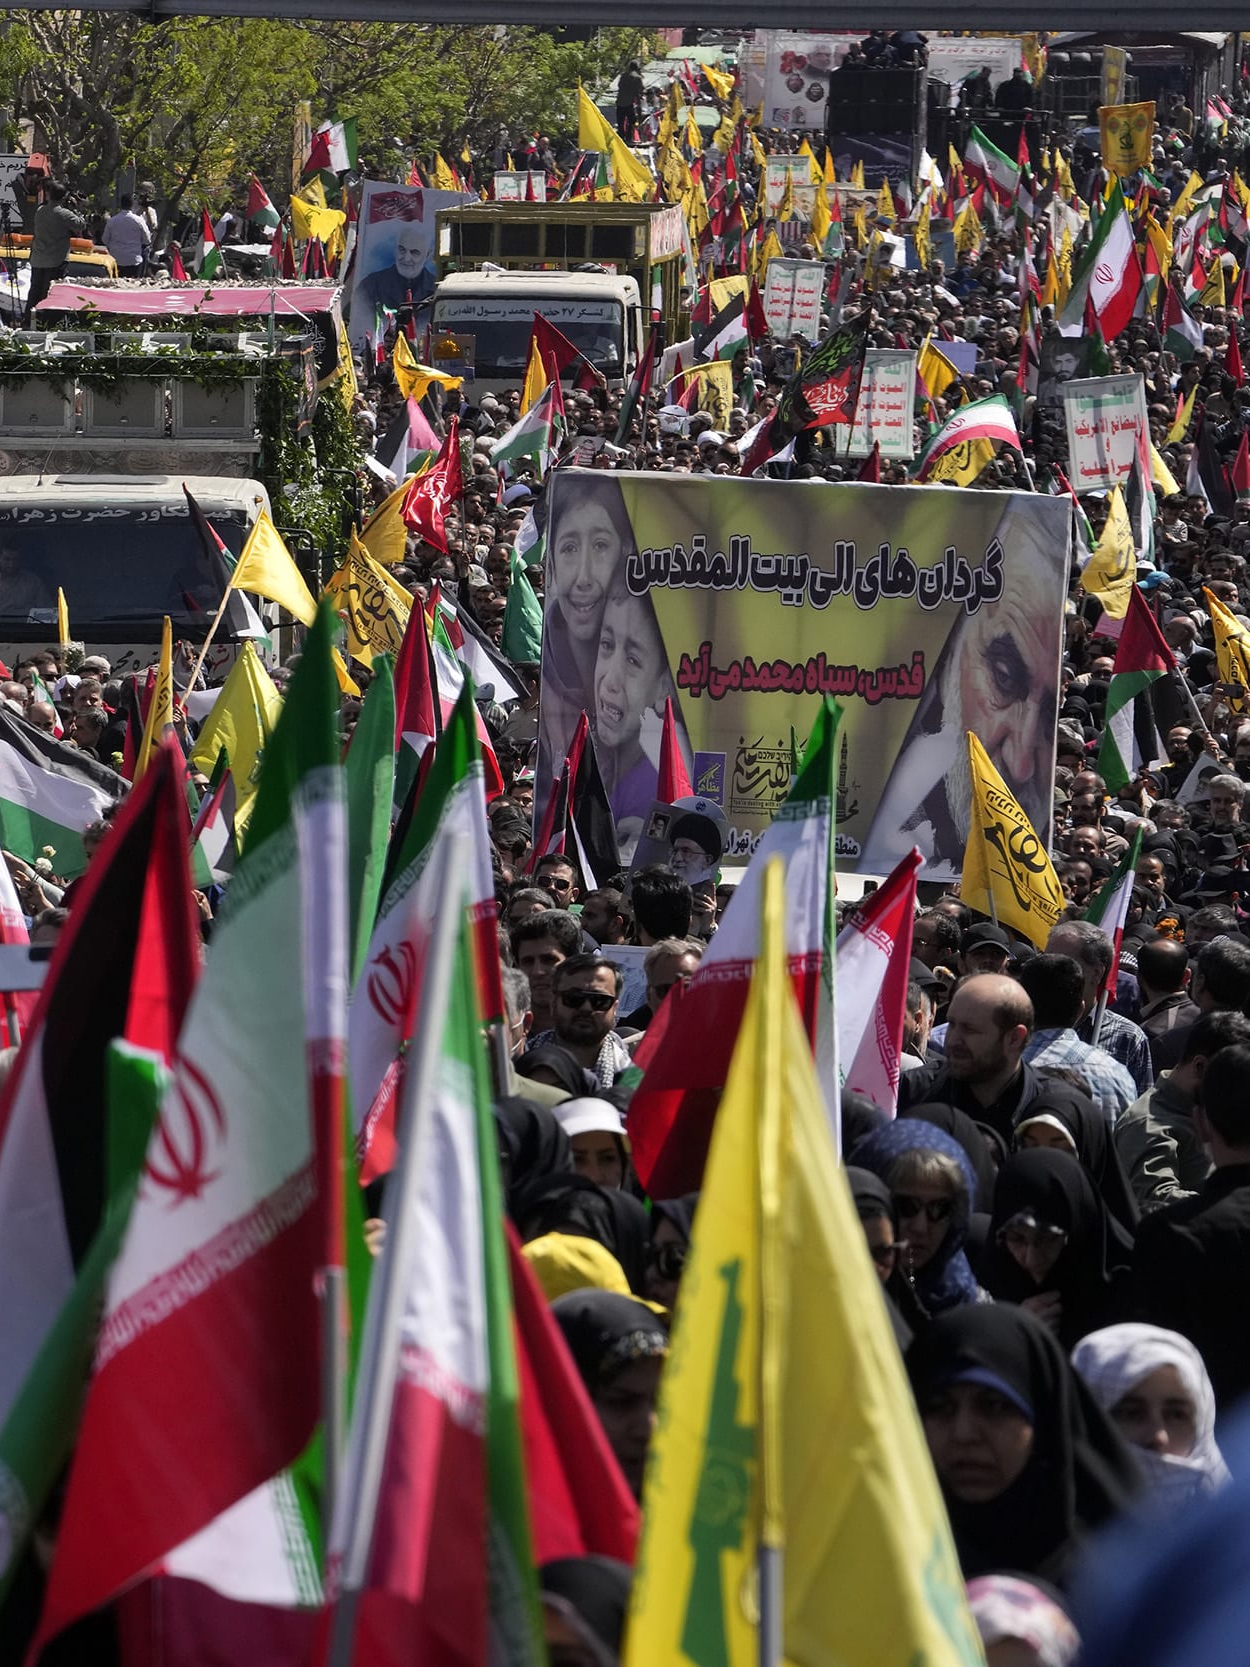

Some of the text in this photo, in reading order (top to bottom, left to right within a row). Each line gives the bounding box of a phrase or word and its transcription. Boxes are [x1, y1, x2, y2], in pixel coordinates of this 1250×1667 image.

[535, 309, 560, 317] حضر
[11, 506, 58, 523] زهرا
[61, 504, 132, 523] حضرت
[136, 504, 191, 523] تکاور
[625, 534, 1005, 615] گردان های الی بیت المقدس
[709, 660, 742, 700] می
[741, 655, 806, 693] محمد
